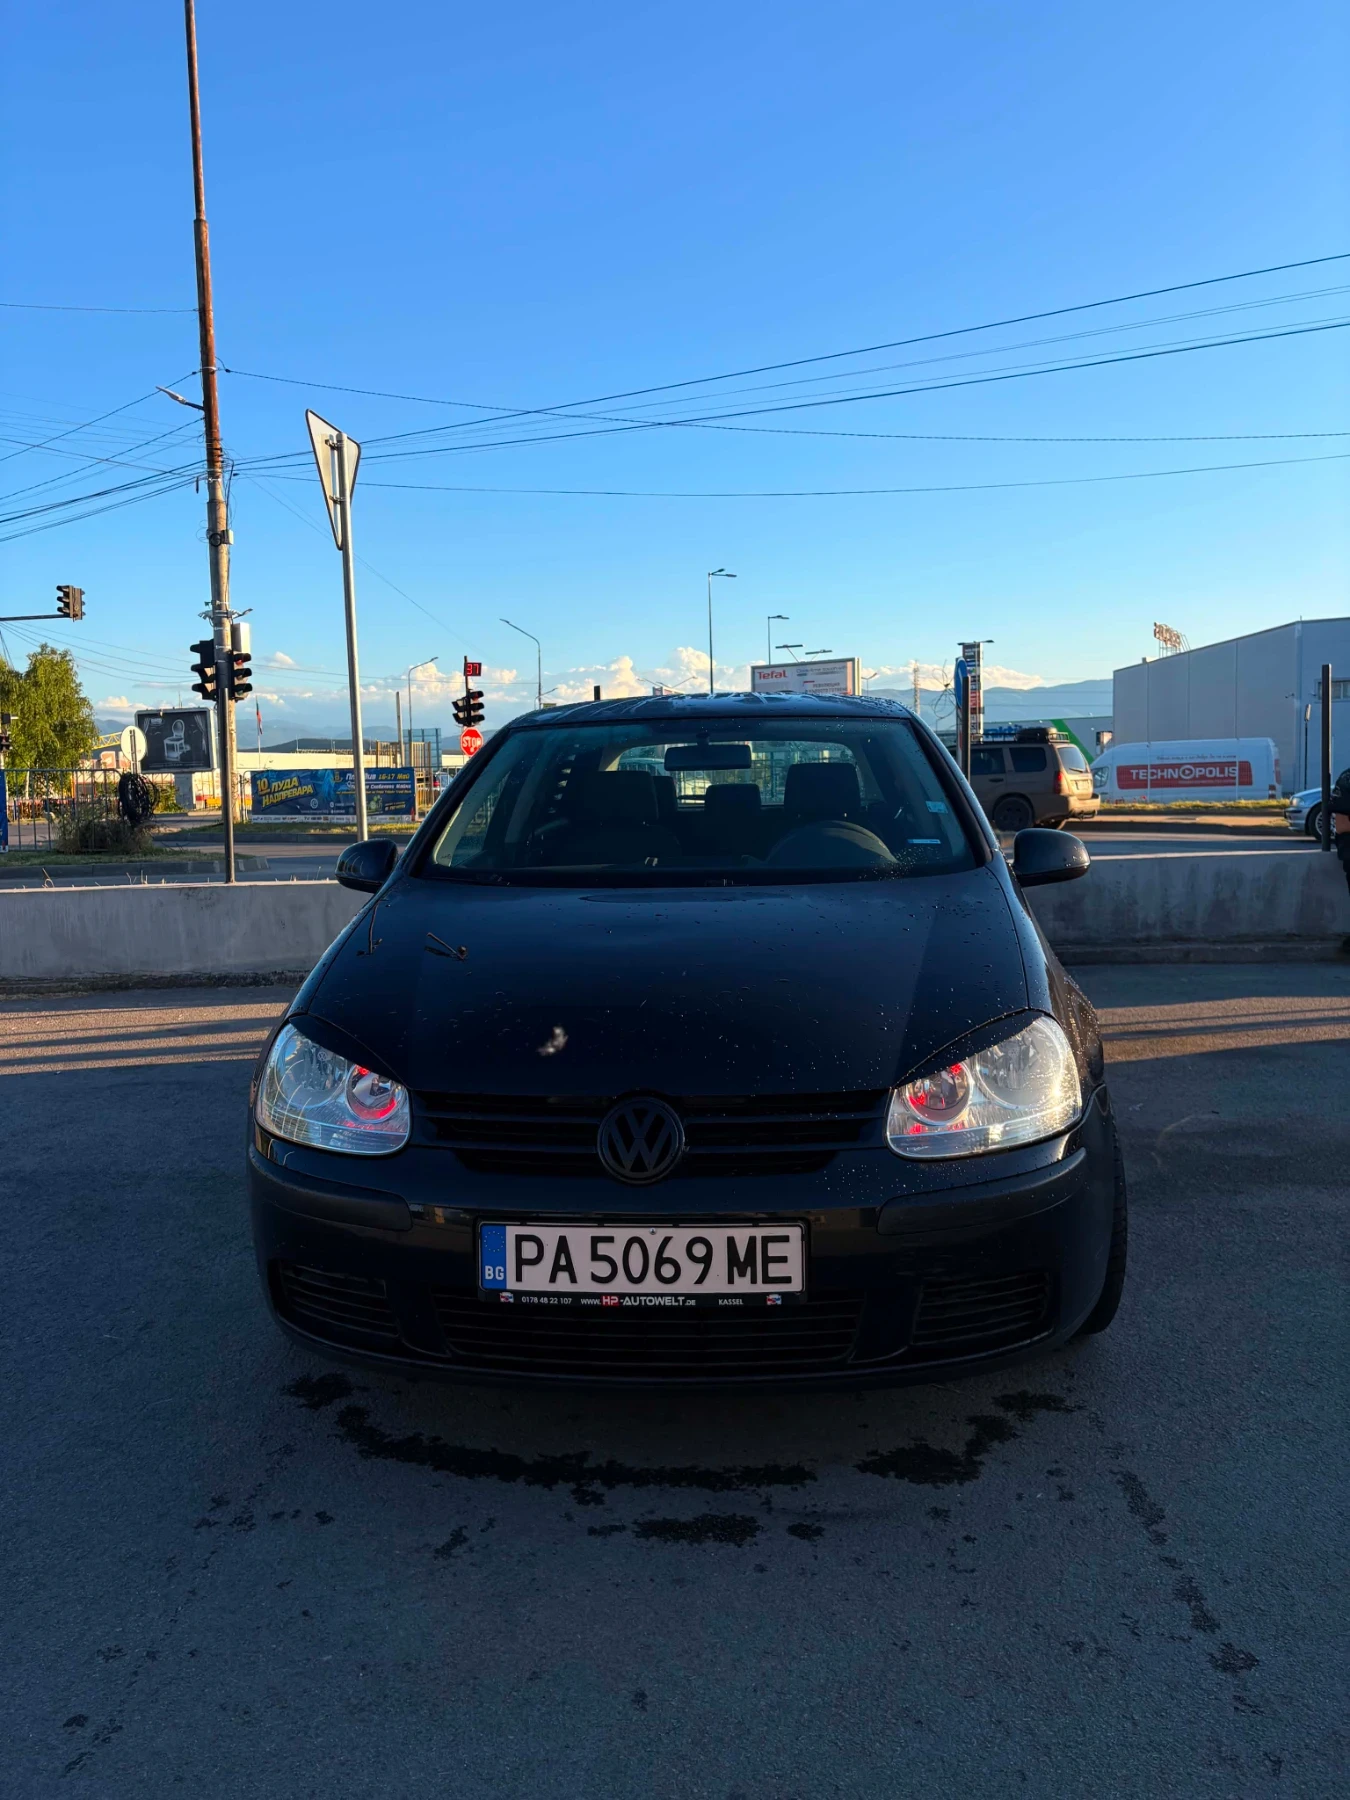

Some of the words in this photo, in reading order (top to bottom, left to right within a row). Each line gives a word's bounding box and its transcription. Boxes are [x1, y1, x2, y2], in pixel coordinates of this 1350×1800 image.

[466, 664, 479, 675] 37
[757, 669, 788, 680] Tefal
[462, 736, 482, 747] STOP
[1130, 765, 1238, 780] TECHNOPOLIS
[262, 784, 314, 808] НАДПРЕВАРА
[485, 1265, 505, 1281] BG
[539, 1296, 548, 1304] 48
[550, 1296, 558, 1304] 22
